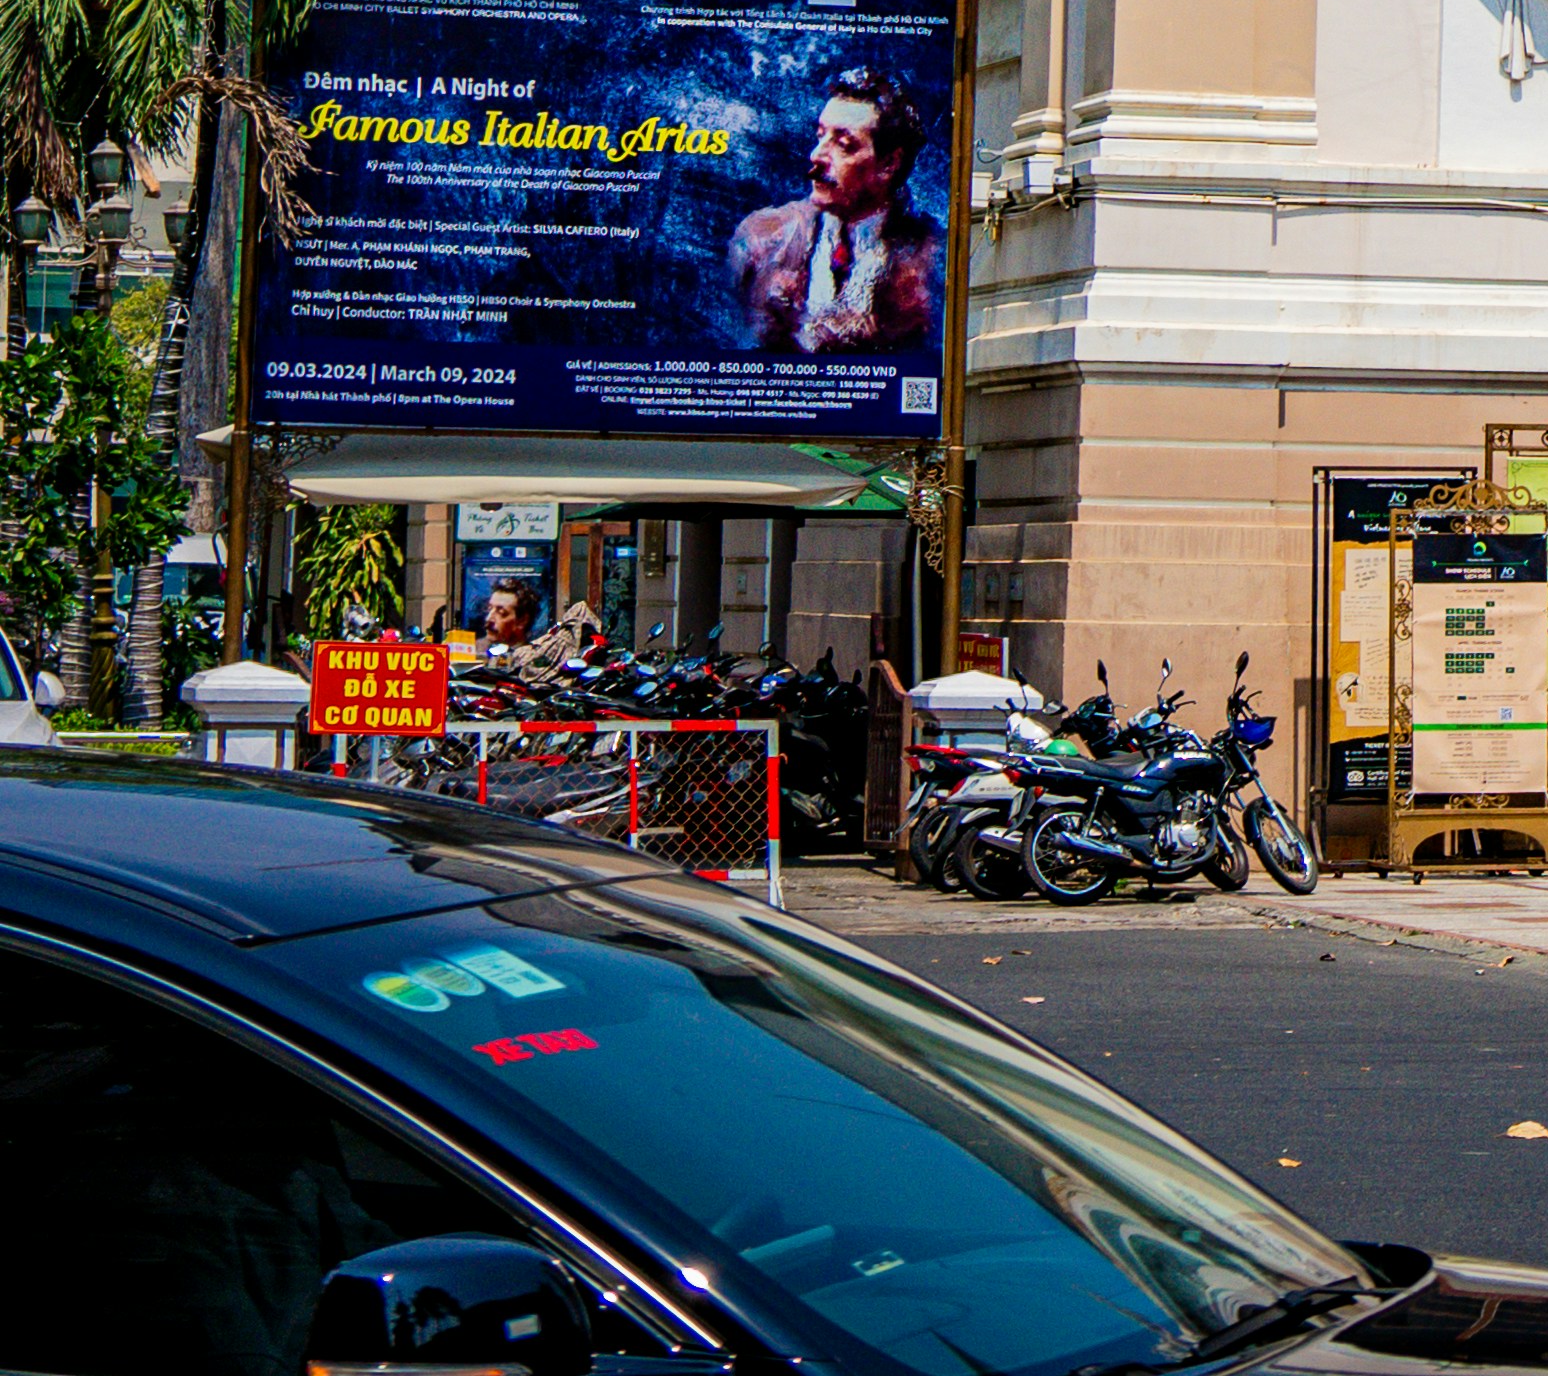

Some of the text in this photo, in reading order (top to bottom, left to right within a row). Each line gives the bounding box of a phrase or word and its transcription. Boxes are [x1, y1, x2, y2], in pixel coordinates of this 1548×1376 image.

[304, 71, 536, 101] Đêm nhạc A Night of
[298, 99, 730, 162] Famous Italian Arias
[533, 224, 564, 235] SILVIA
[312, 304, 334, 320] huy
[342, 306, 405, 320] Conductor:
[475, 311, 508, 323] MINH
[266, 361, 516, 385] 09.03.2024 March 09, 2024
[654, 360, 897, 377] 1.000.000 850.000 700.000 550.000 VND
[328, 650, 435, 675] KHU VỰC
[344, 671, 416, 699] ĐỖ XE
[324, 704, 432, 727] CƠ QUAN
[472, 1037, 534, 1066] XE
